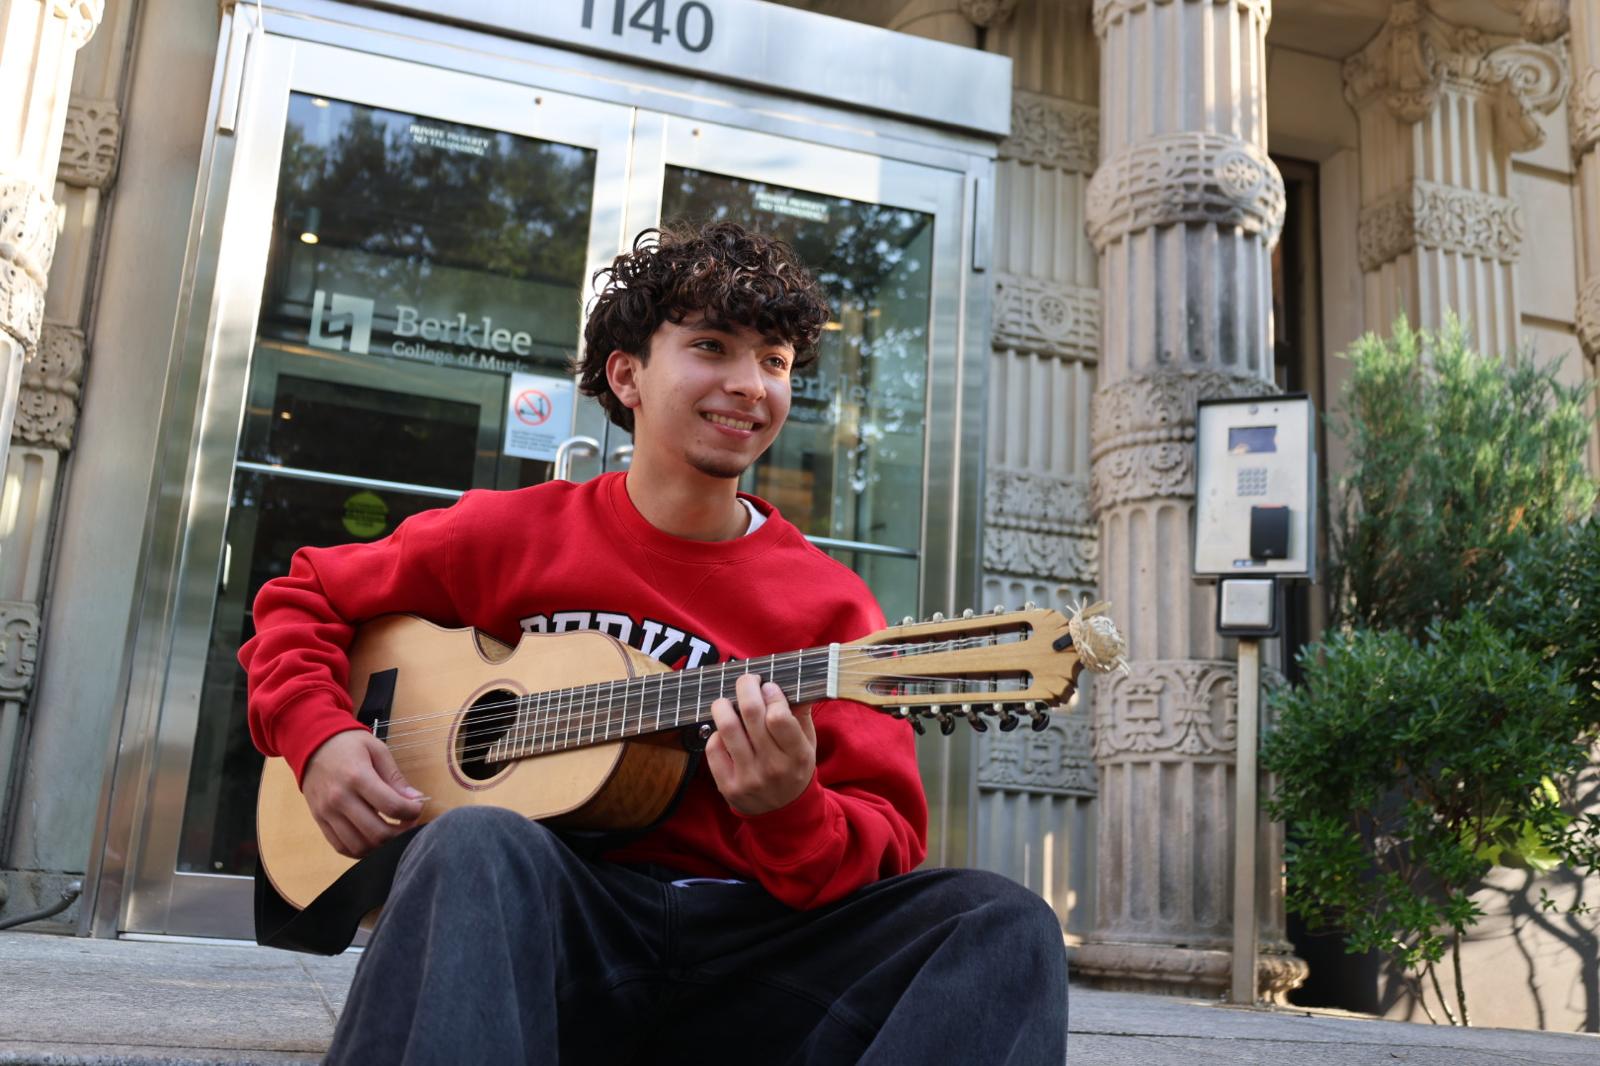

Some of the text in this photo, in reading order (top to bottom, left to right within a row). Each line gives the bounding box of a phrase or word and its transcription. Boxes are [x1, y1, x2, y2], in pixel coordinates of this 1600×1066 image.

[581, 0, 714, 53] 1140
[409, 124, 445, 139] PRIVATE
[392, 305, 532, 356] Berklee
[391, 340, 530, 373] College of Music
